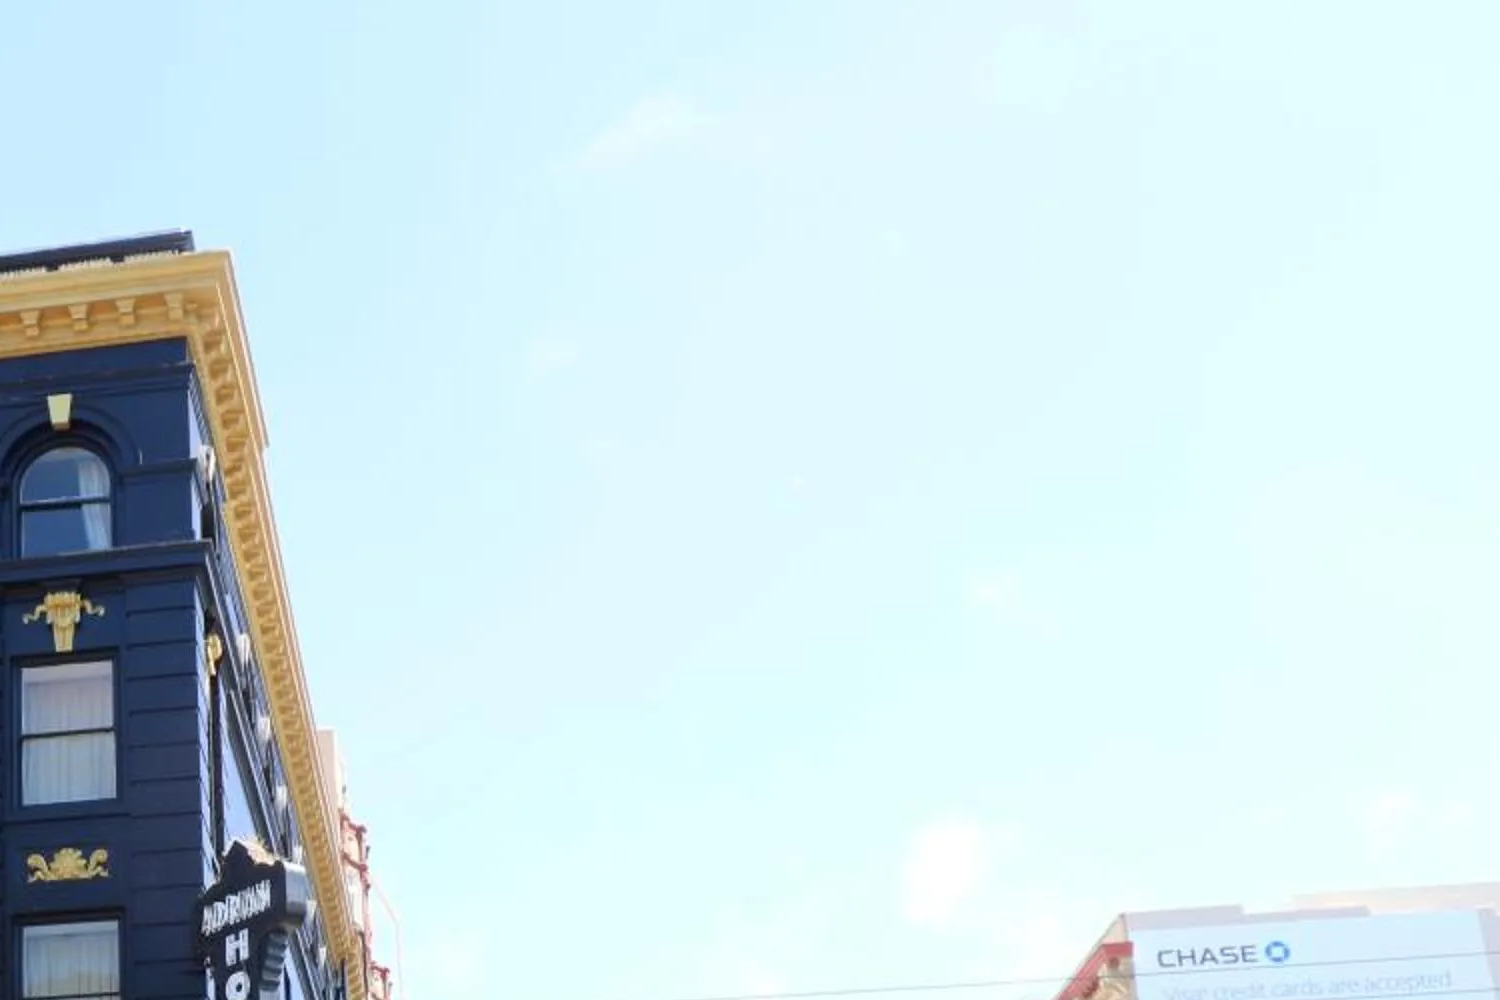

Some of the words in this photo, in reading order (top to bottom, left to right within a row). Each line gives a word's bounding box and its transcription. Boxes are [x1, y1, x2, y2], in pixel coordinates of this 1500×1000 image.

[1157, 944, 1260, 968] CHASE
[1270, 976, 1324, 996] cards
[1328, 978, 1361, 993] are
[1365, 969, 1452, 996] accepted
